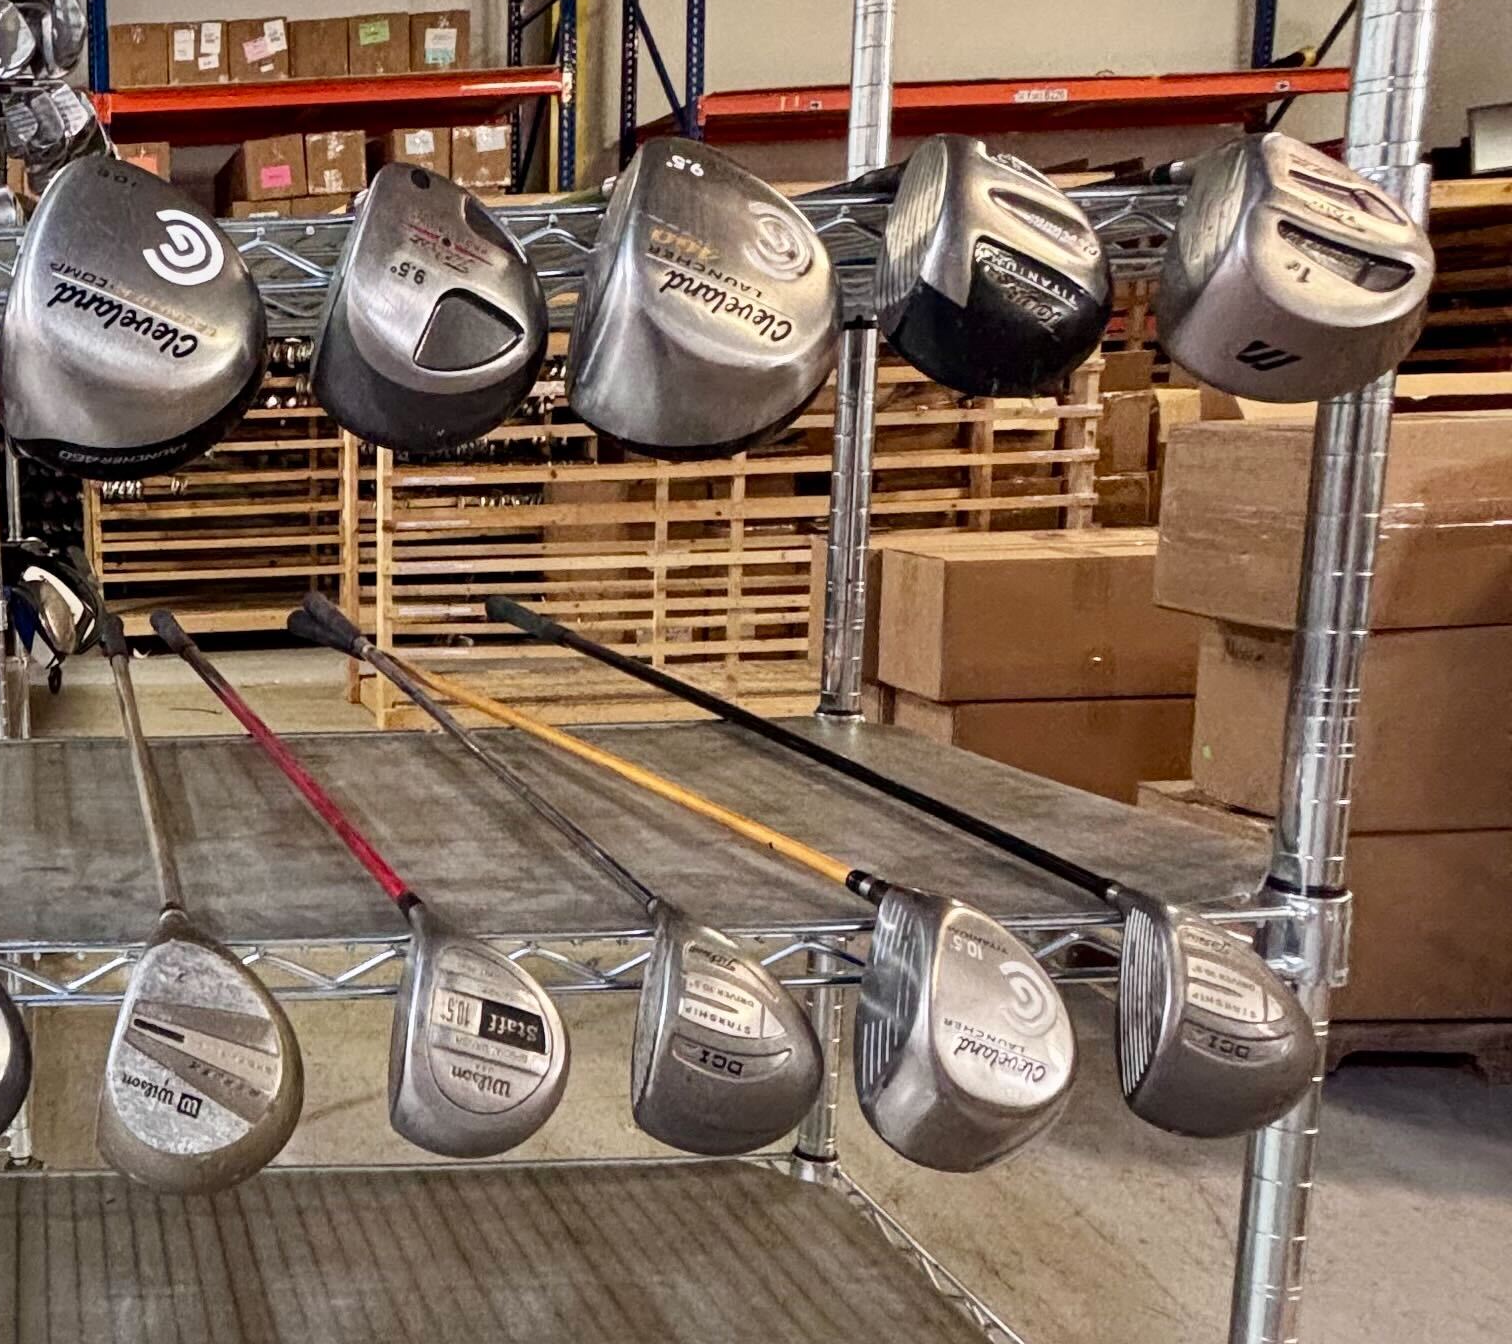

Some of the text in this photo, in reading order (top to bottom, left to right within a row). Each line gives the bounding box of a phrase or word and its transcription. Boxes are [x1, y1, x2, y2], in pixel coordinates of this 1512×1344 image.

[390, 262, 425, 285] 9.5°
[646, 244, 763, 299] LAUNCHER
[46, 282, 197, 359] Cleveland
[660, 269, 791, 343] Cleveland
[487, 1013, 538, 1042] Staff
[684, 1005, 752, 1034] STARSHIP
[943, 1018, 1025, 1053] LAUNCHER
[1208, 1035, 1250, 1059] DCI
[700, 1050, 744, 1076] DCI
[954, 1036, 1046, 1083] Cleveland
[121, 1076, 174, 1105] Wilson
[450, 1065, 510, 1098] Wilson
